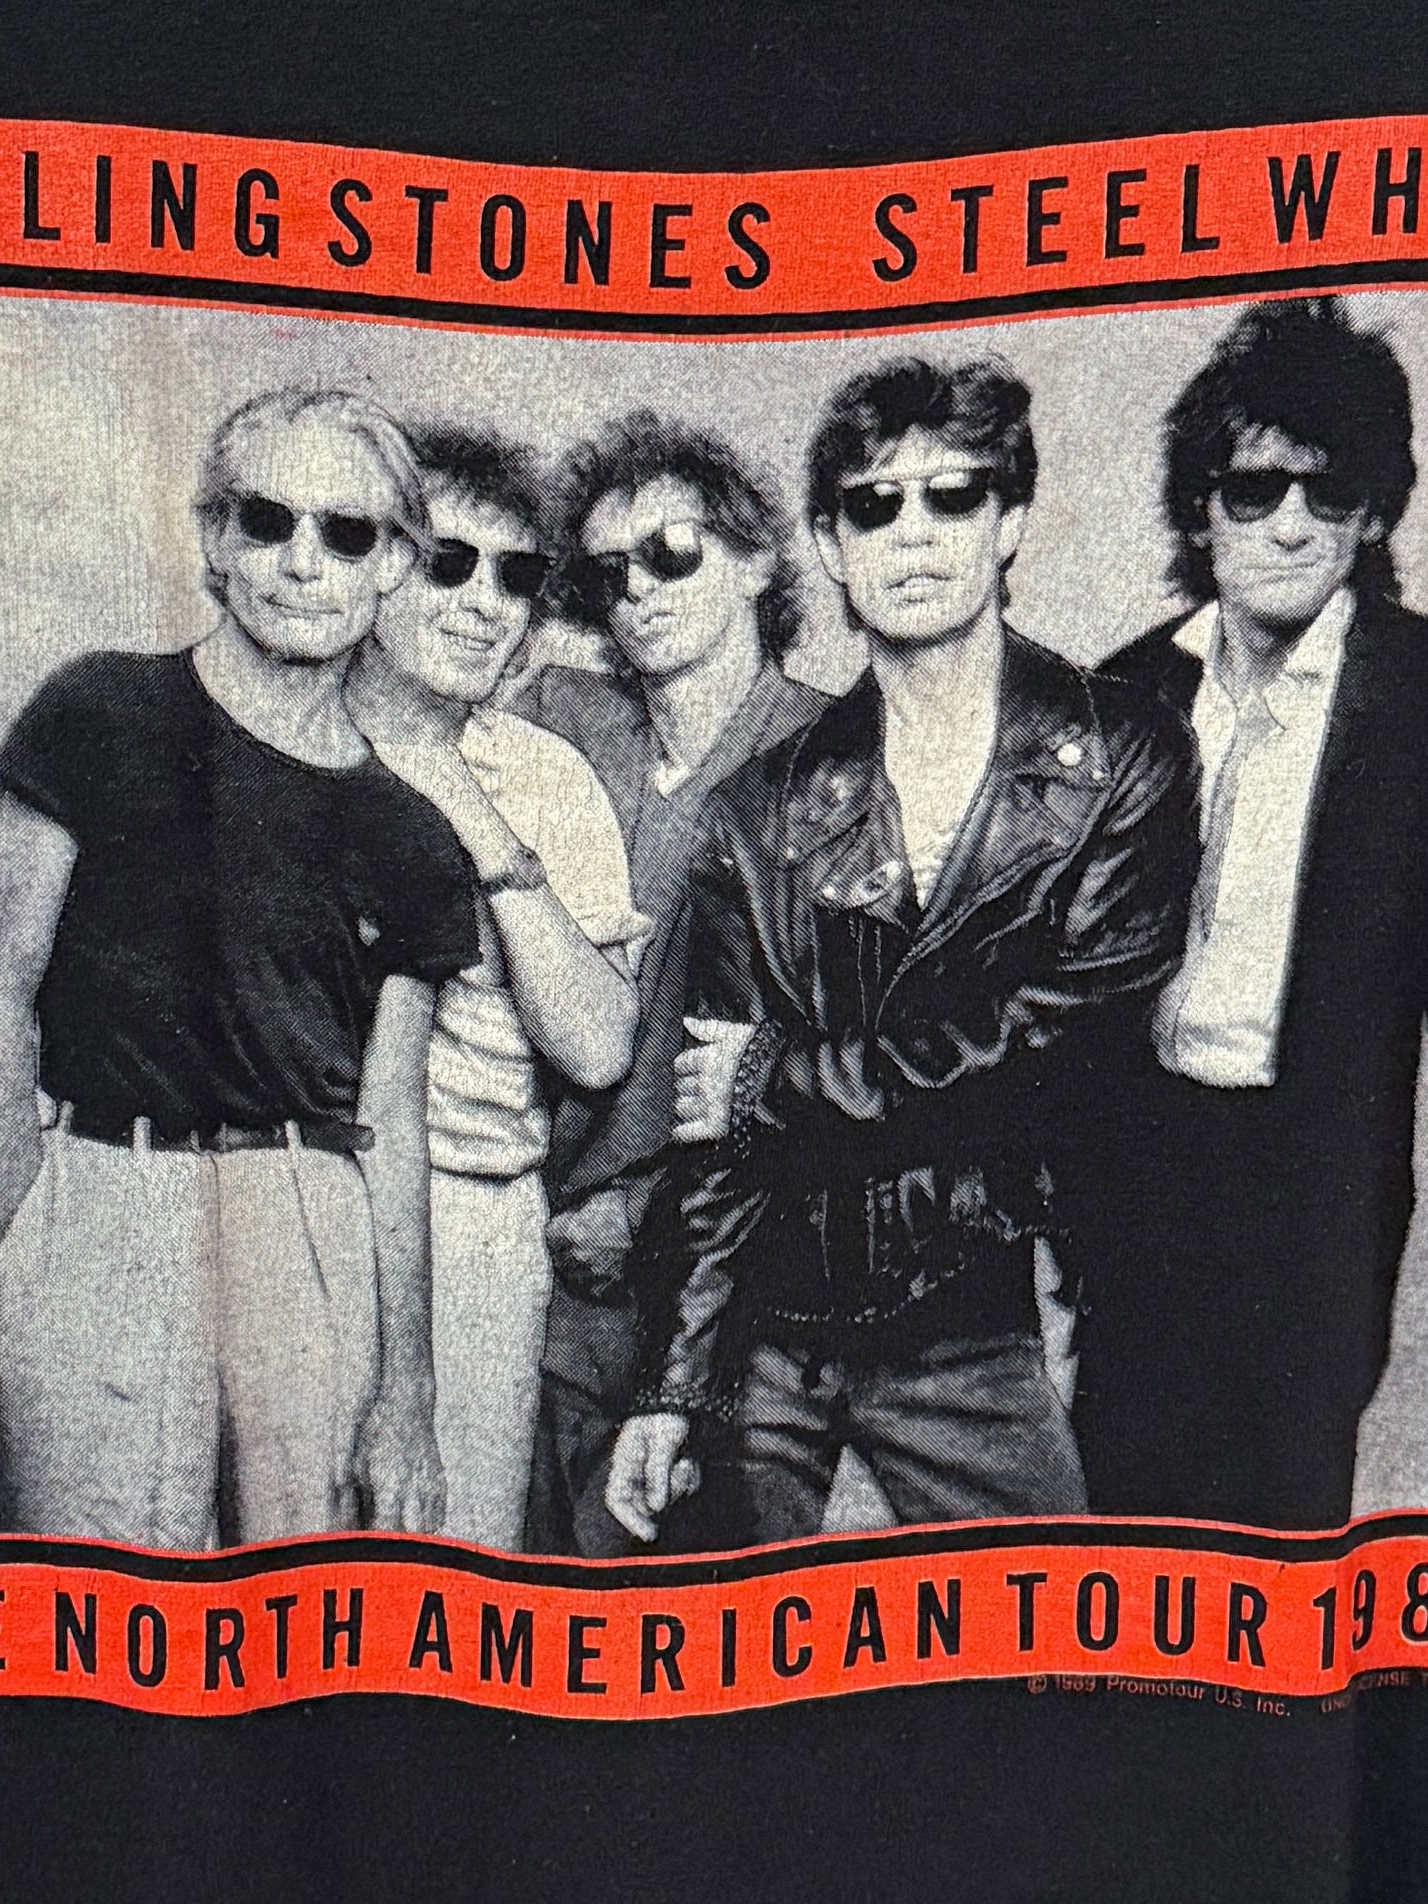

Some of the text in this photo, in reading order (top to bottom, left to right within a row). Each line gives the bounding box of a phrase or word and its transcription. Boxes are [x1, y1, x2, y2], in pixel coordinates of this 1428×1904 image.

[327, 179, 771, 291] STONES
[872, 165, 1220, 283] STEEL
[55, 1589, 363, 1690] NORTH
[408, 1579, 961, 1694] AMERICAN
[1006, 1571, 1268, 1667] TOUR
[1256, 1696, 1291, 1717] Inc.
